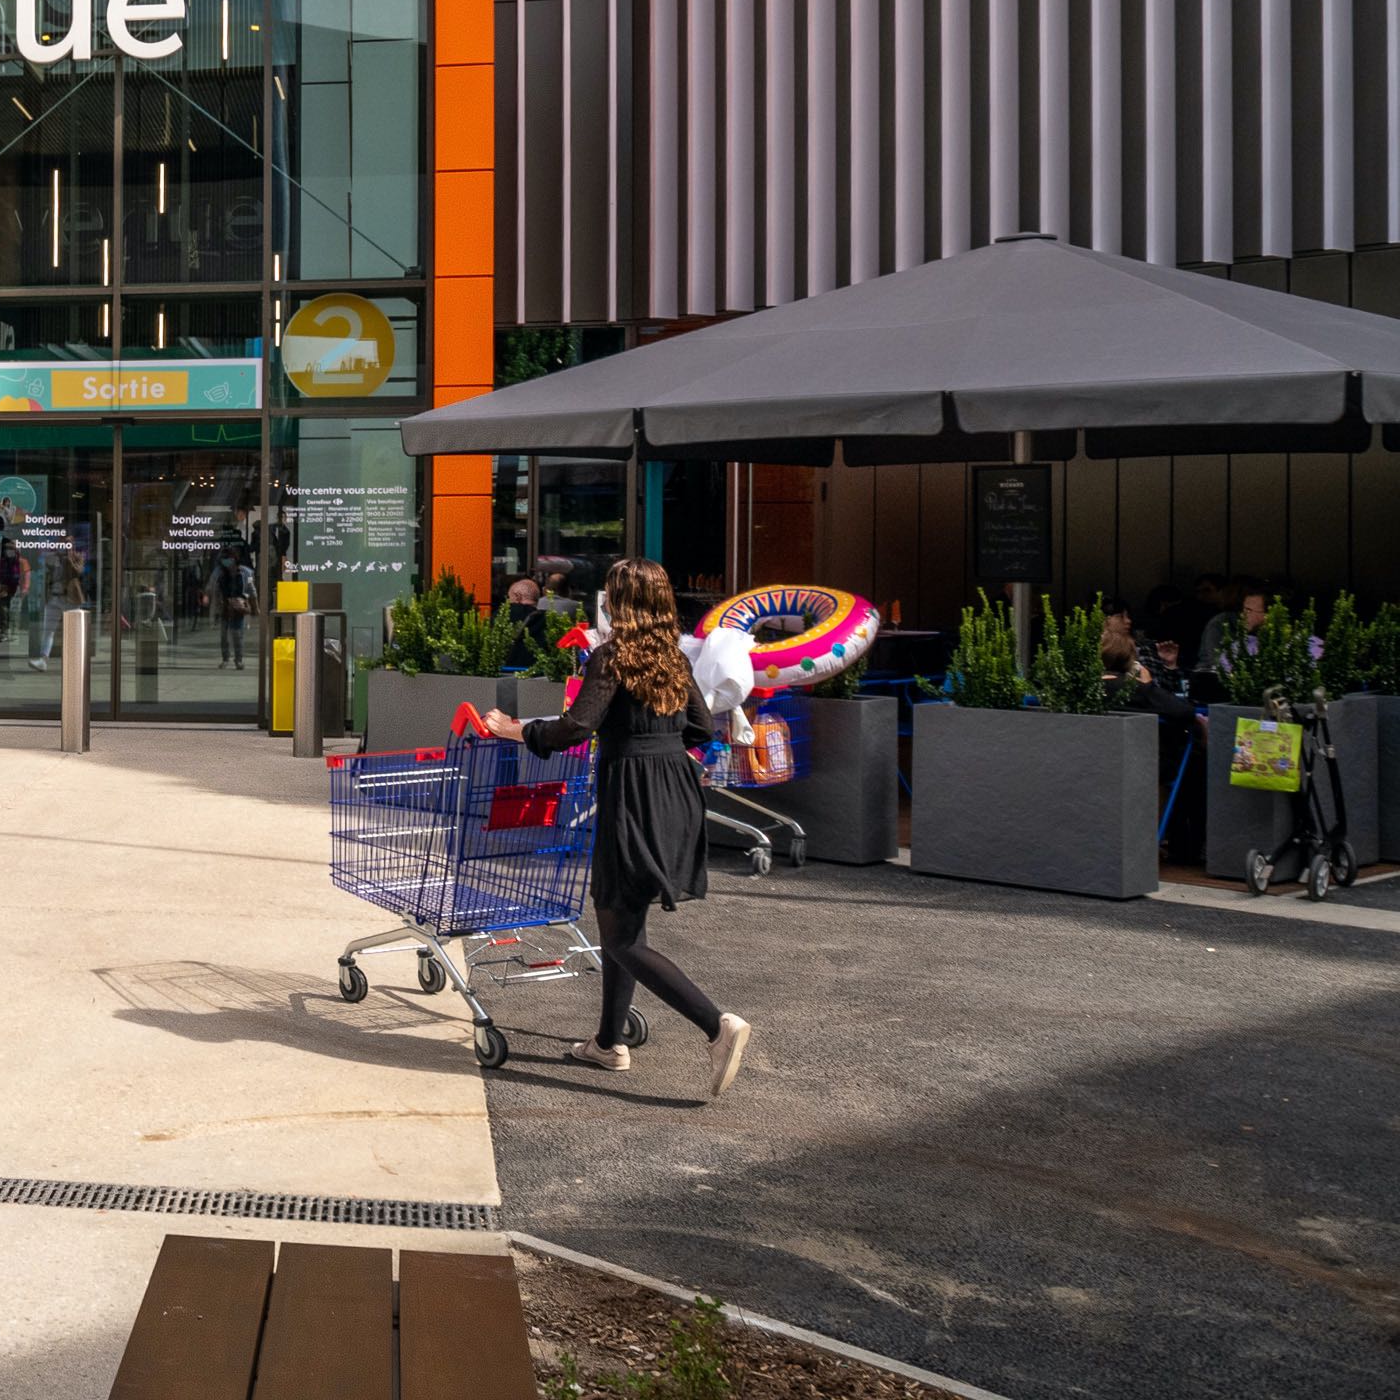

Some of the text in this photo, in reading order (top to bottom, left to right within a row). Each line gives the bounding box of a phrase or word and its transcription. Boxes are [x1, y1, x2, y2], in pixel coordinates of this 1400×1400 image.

[82, 376, 165, 400] Sortie
[286, 487, 311, 495] Votre
[312, 487, 341, 495] centre
[367, 486, 408, 494] accueille
[25, 514, 65, 525] bonjour
[172, 514, 212, 526] bonjour
[22, 527, 66, 537] welcome
[169, 527, 214, 538] welcome
[162, 539, 221, 552] buongiorno
